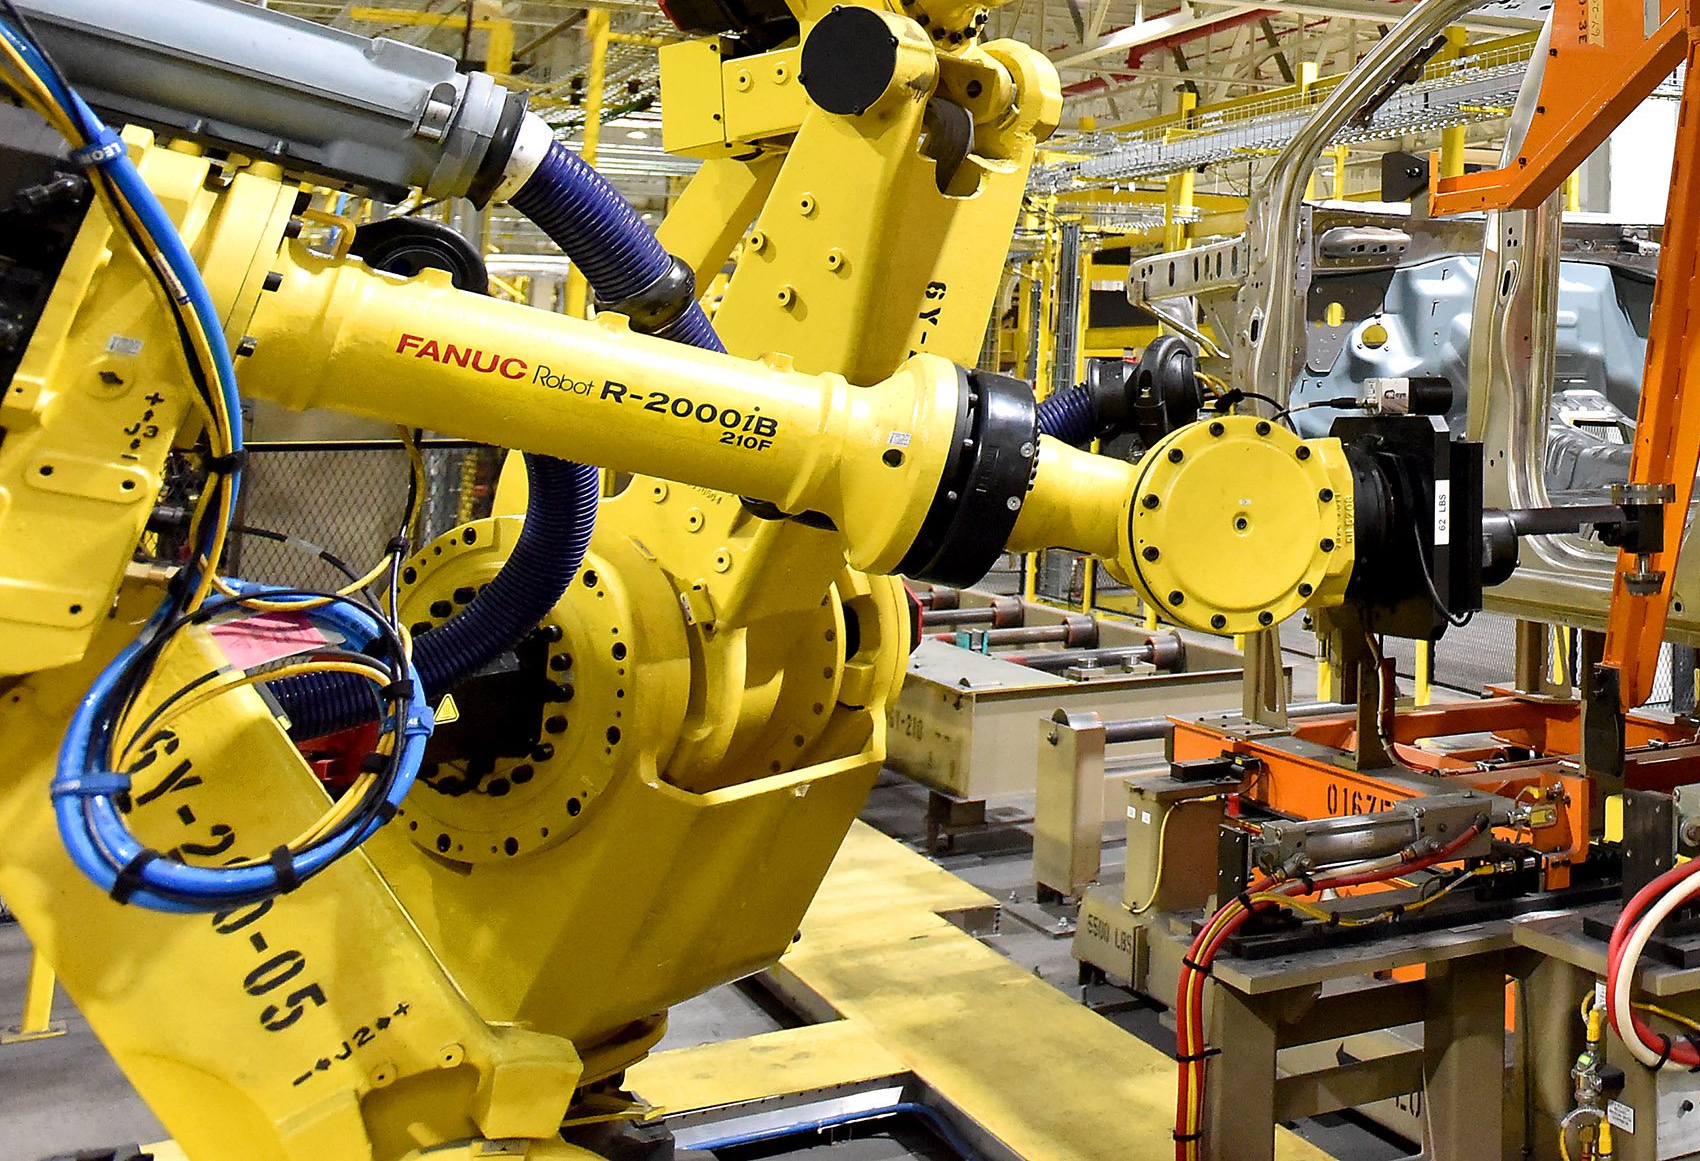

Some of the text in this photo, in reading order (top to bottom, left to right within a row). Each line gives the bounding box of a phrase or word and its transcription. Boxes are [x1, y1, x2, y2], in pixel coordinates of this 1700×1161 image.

[908, 281, 947, 359] 6Y-
[395, 333, 779, 439] FANUC Robot R-2000iB
[718, 431, 774, 453] 210F
[1439, 519, 1446, 531] 62
